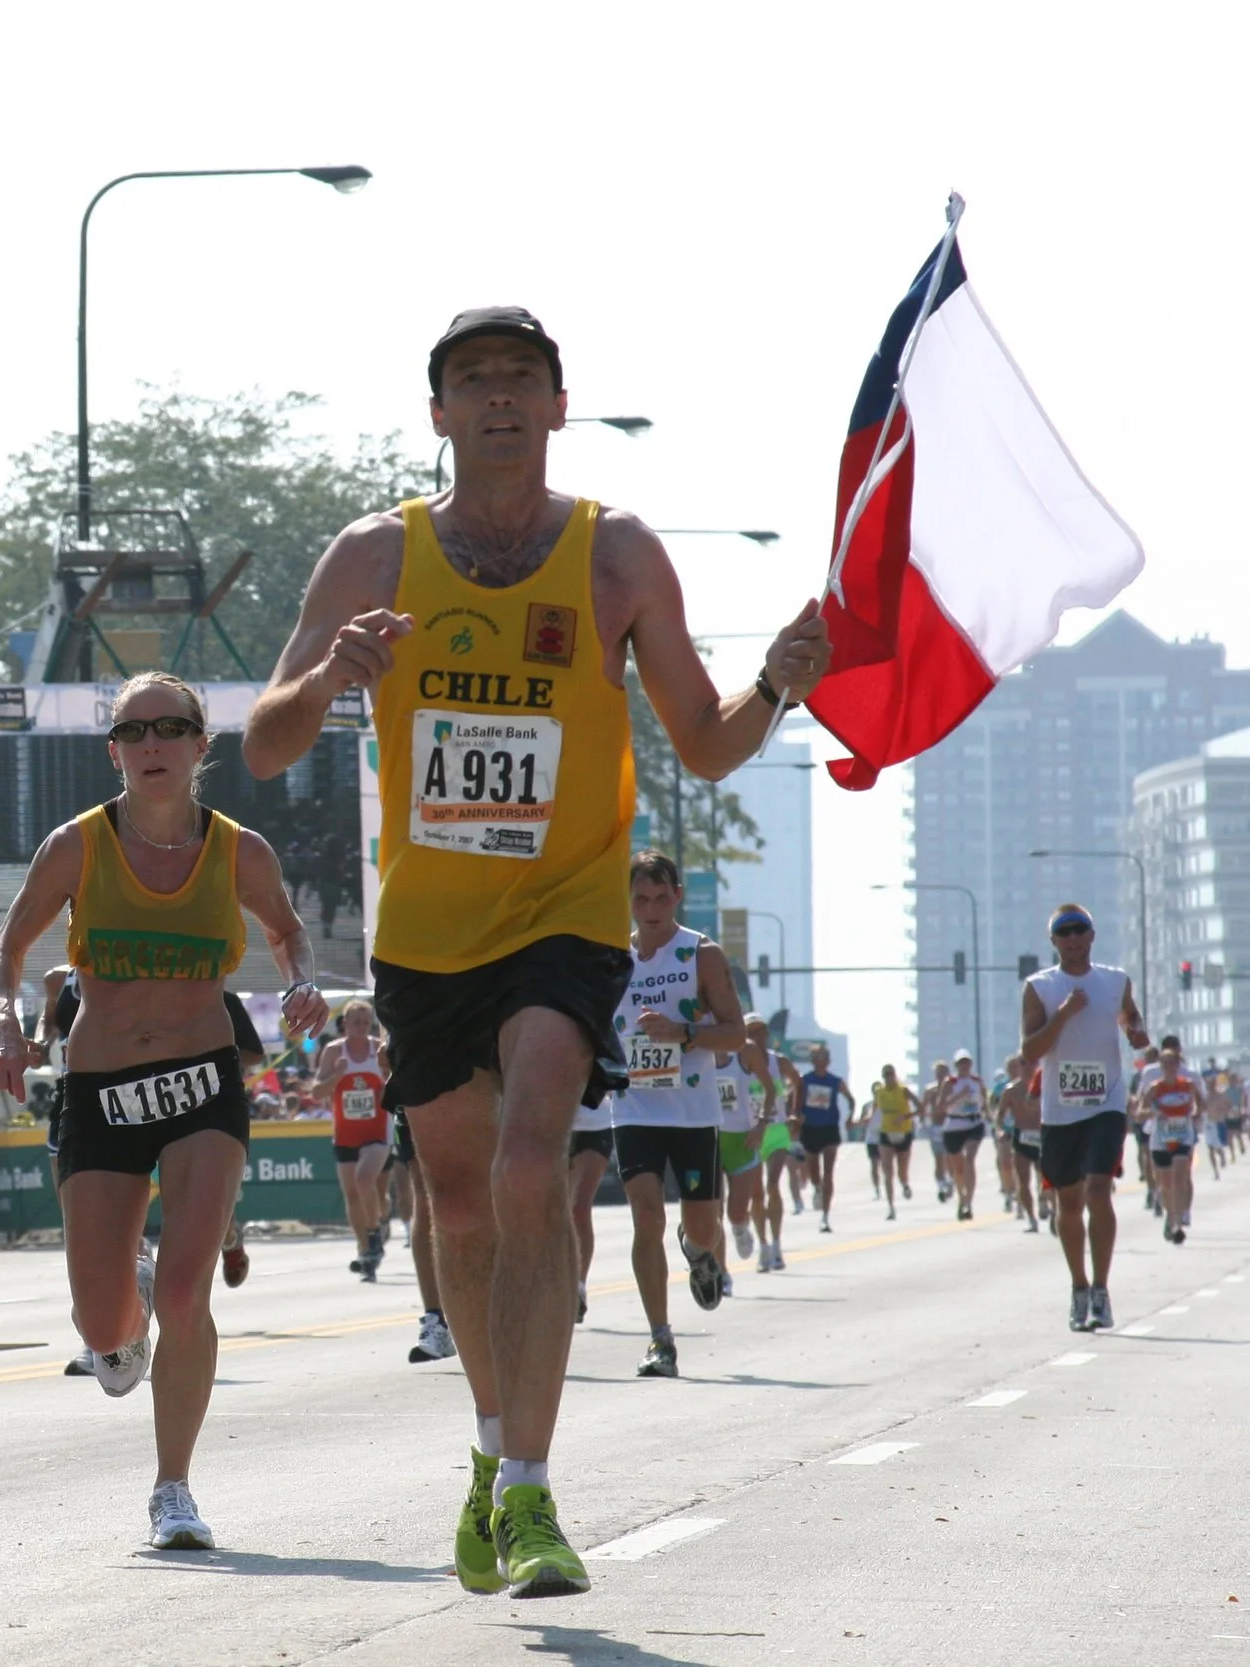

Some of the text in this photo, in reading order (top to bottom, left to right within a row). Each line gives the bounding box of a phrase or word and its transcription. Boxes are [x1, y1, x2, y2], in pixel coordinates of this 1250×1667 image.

[419, 669, 554, 710] CHILE
[456, 725, 538, 740] LaSalle Bank
[424, 747, 537, 805] A 931
[458, 807, 546, 820] ANNIVERSARY
[632, 990, 667, 1006] Paul
[641, 1049, 673, 1069] 537
[1059, 1072, 1105, 1091] B 2483
[106, 1066, 213, 1124] A 1631
[258, 1157, 313, 1181] Bank
